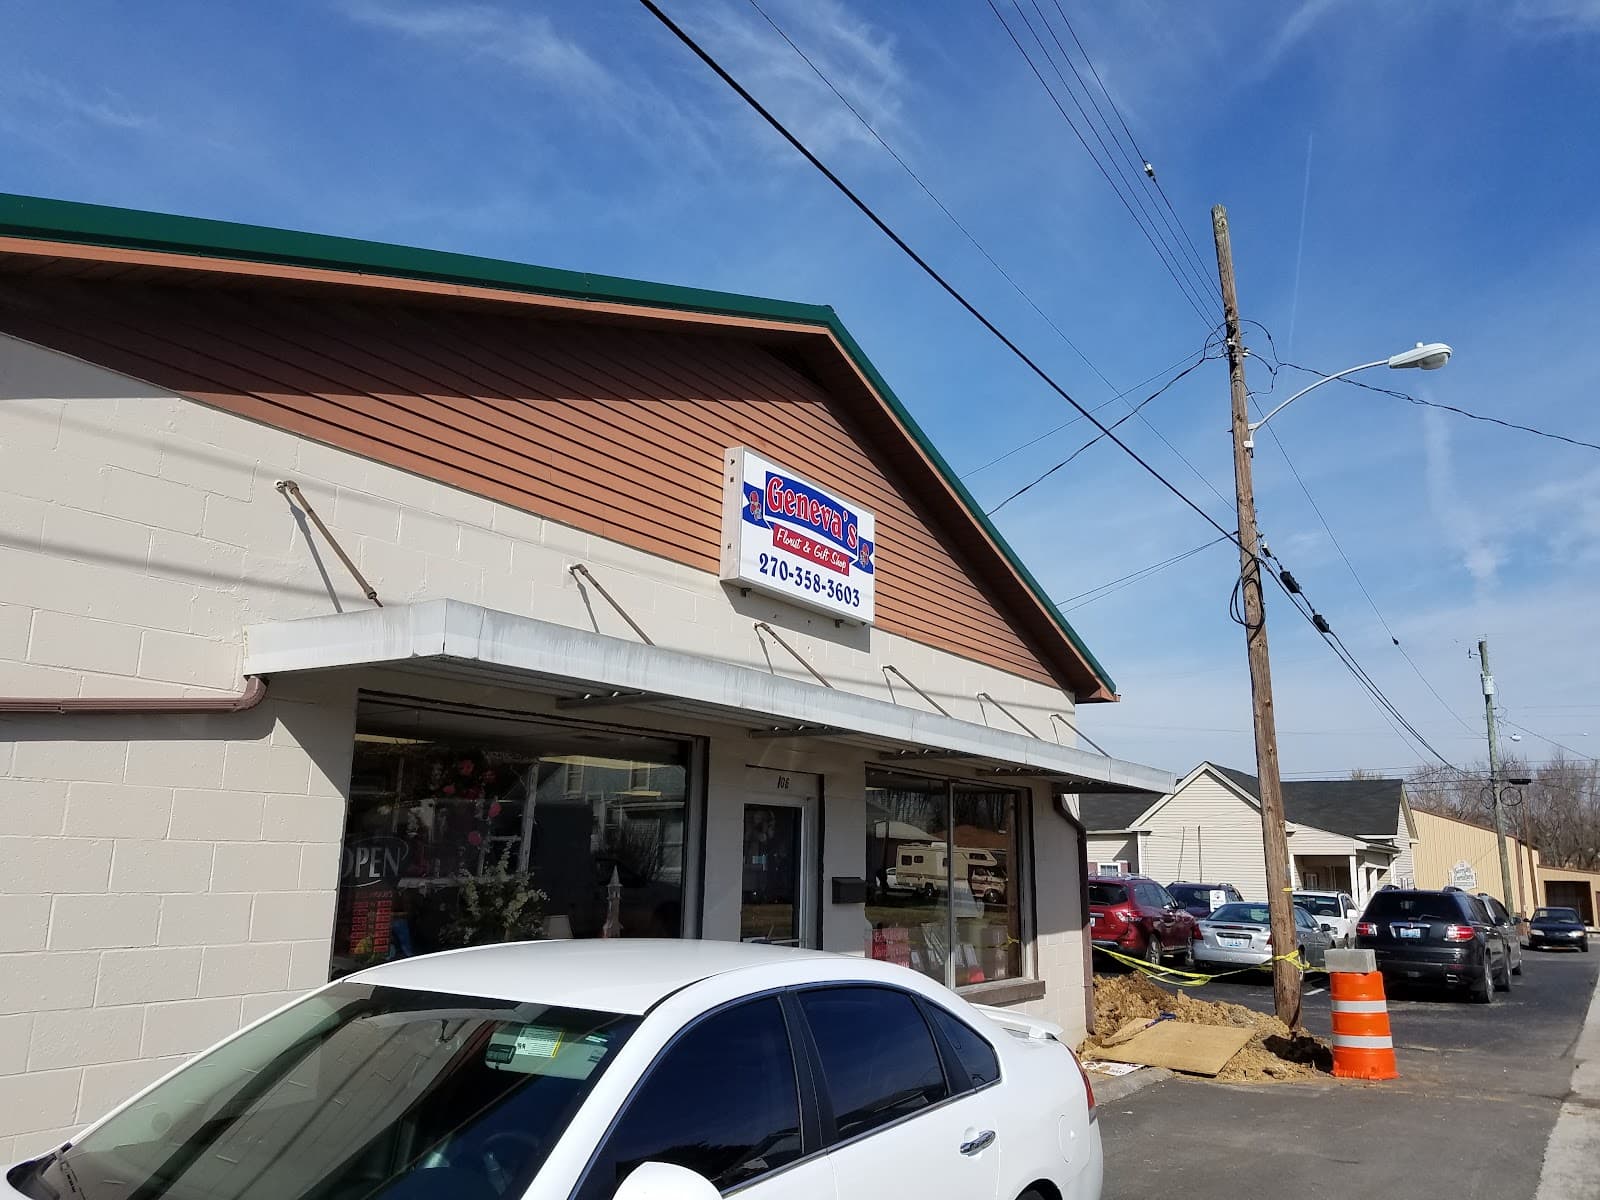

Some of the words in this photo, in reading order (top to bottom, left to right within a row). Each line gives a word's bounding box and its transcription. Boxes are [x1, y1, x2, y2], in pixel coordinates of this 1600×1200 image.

[767, 477, 857, 549] Geneva's
[777, 528, 801, 549] Florist
[803, 541, 811, 553] &
[814, 545, 830, 561] Gift
[831, 552, 847, 572] Shop
[759, 553, 860, 607] 270-358-3603
